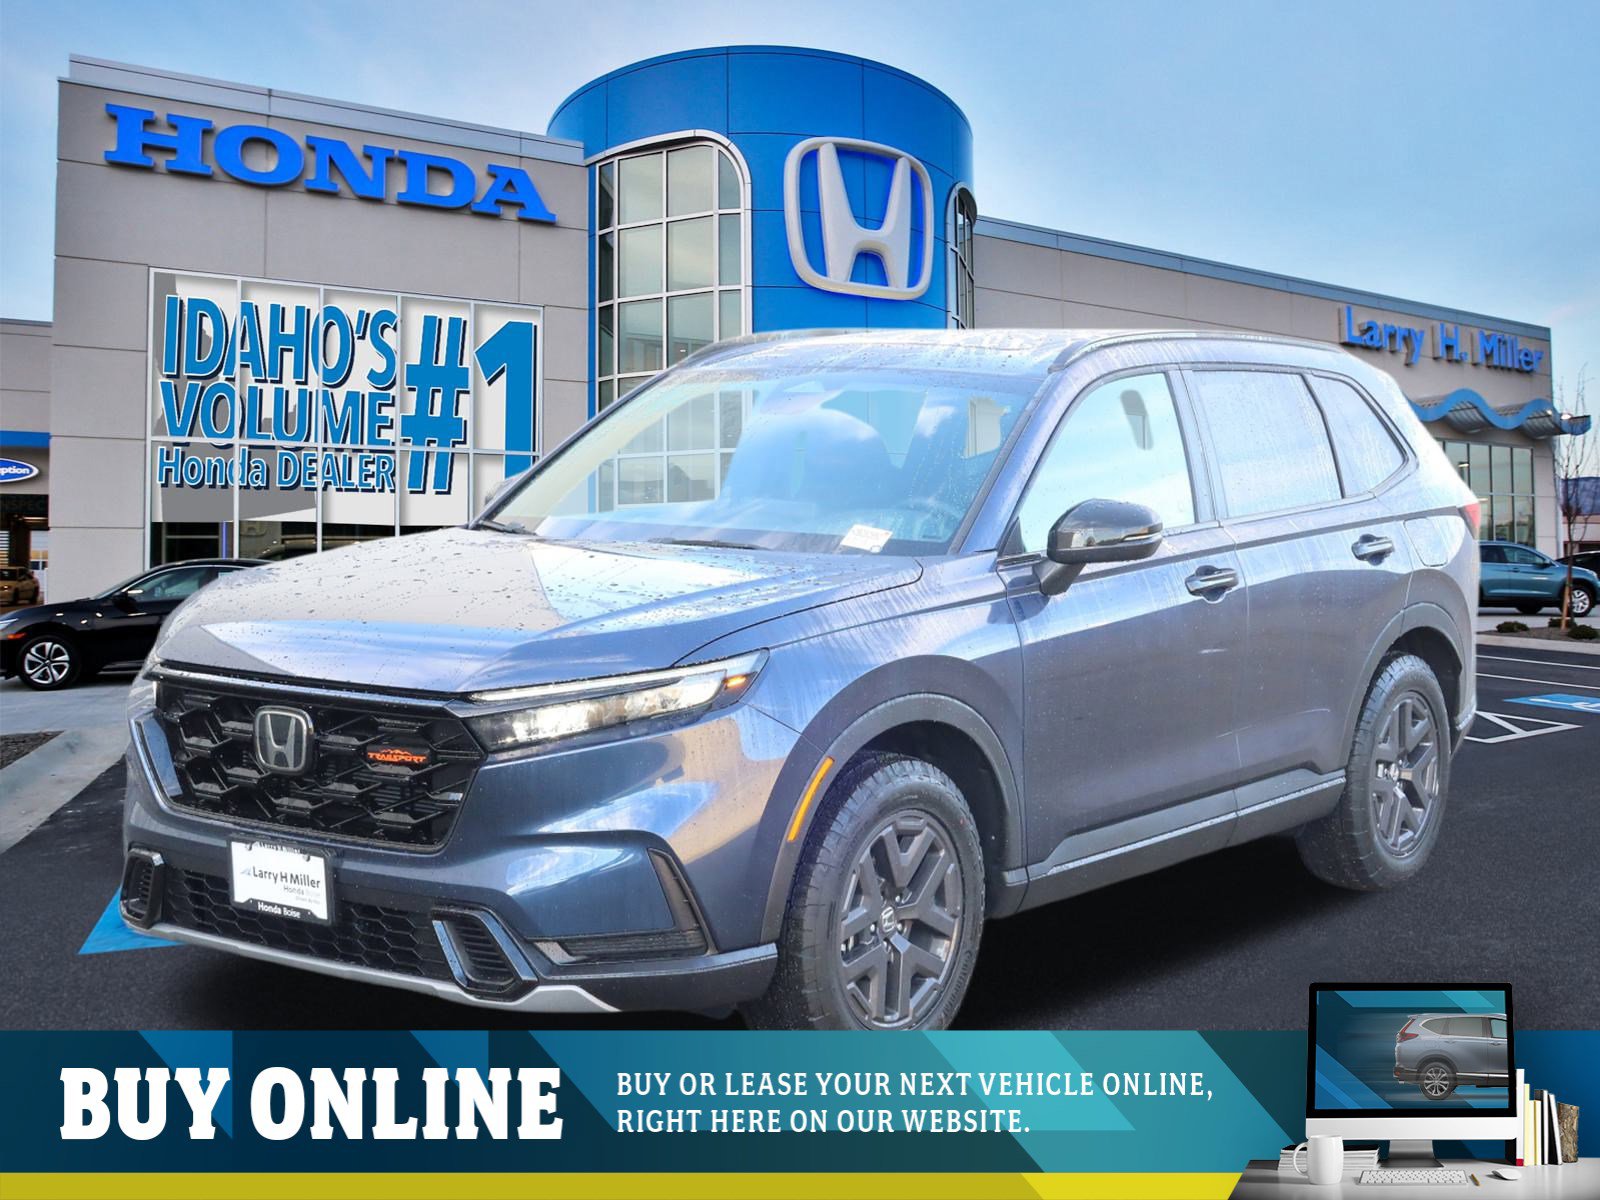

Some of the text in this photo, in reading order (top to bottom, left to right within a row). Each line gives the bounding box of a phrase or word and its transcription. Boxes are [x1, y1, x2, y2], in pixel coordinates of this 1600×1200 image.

[104, 103, 557, 223] HONDA
[162, 295, 398, 390] IDAHO'S
[1339, 305, 1545, 374] Larry H. Miller
[159, 380, 396, 450] VOLUME
[400, 314, 538, 495] #1
[0, 466, 29, 476] ption
[157, 446, 396, 493] Honda DEALER
[252, 865, 321, 889] Larry H Miller
[257, 901, 301, 919] Honda Boise
